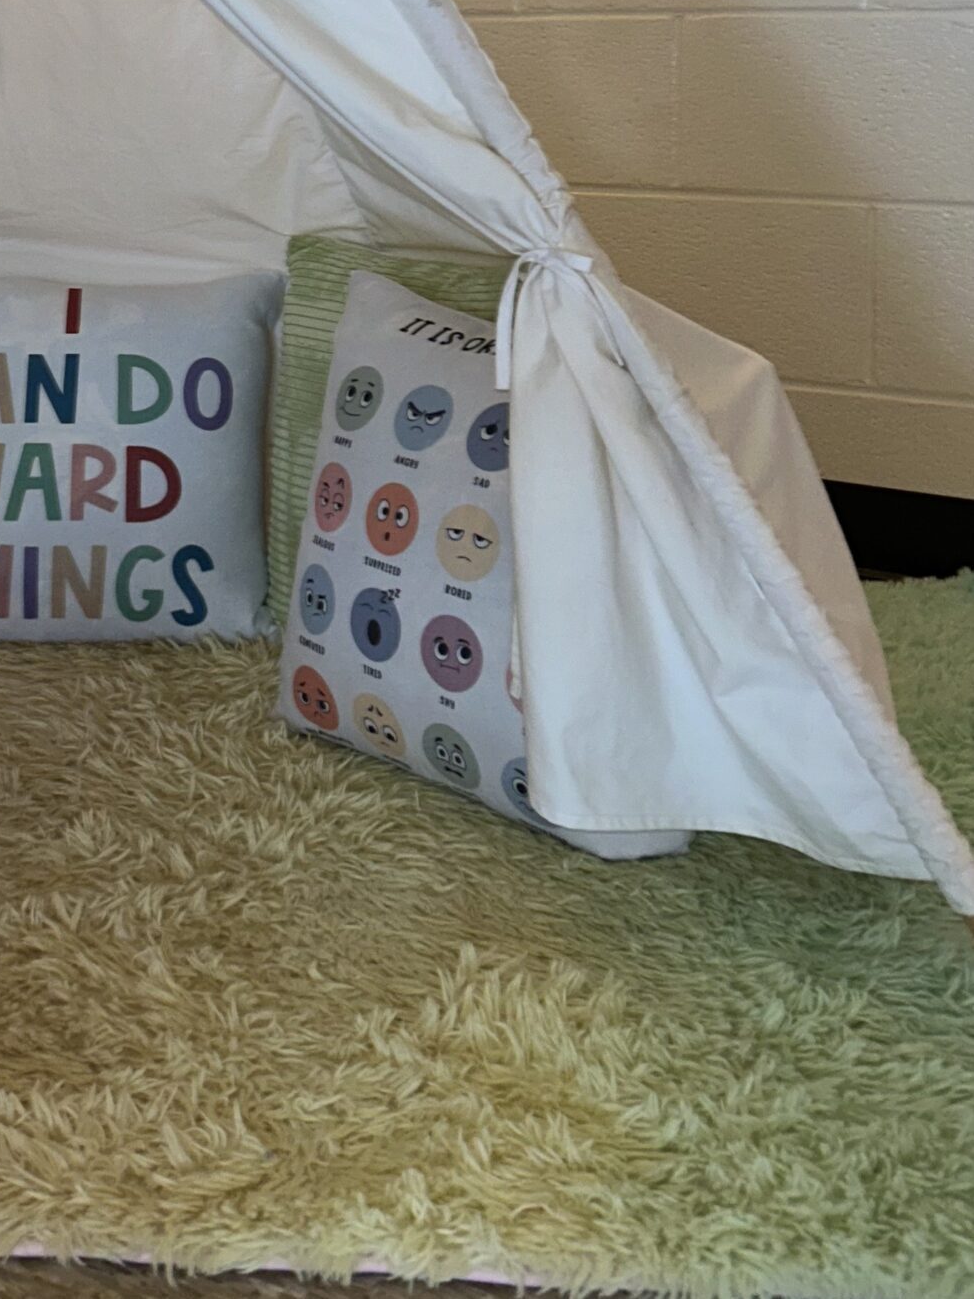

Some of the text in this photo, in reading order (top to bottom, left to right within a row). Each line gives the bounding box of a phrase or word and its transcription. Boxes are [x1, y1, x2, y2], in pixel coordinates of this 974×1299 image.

[65, 288, 82, 334] I
[399, 318, 497, 356] IT IS OK
[117, 353, 233, 431] DO
[334, 436, 353, 449] HAPPY
[394, 455, 420, 469] ANGRY
[472, 476, 491, 488] SAD
[364, 556, 402, 577] SURPRISED
[445, 584, 472, 601] BORED
[363, 664, 383, 679] TIRED
[440, 696, 456, 710] SHY
